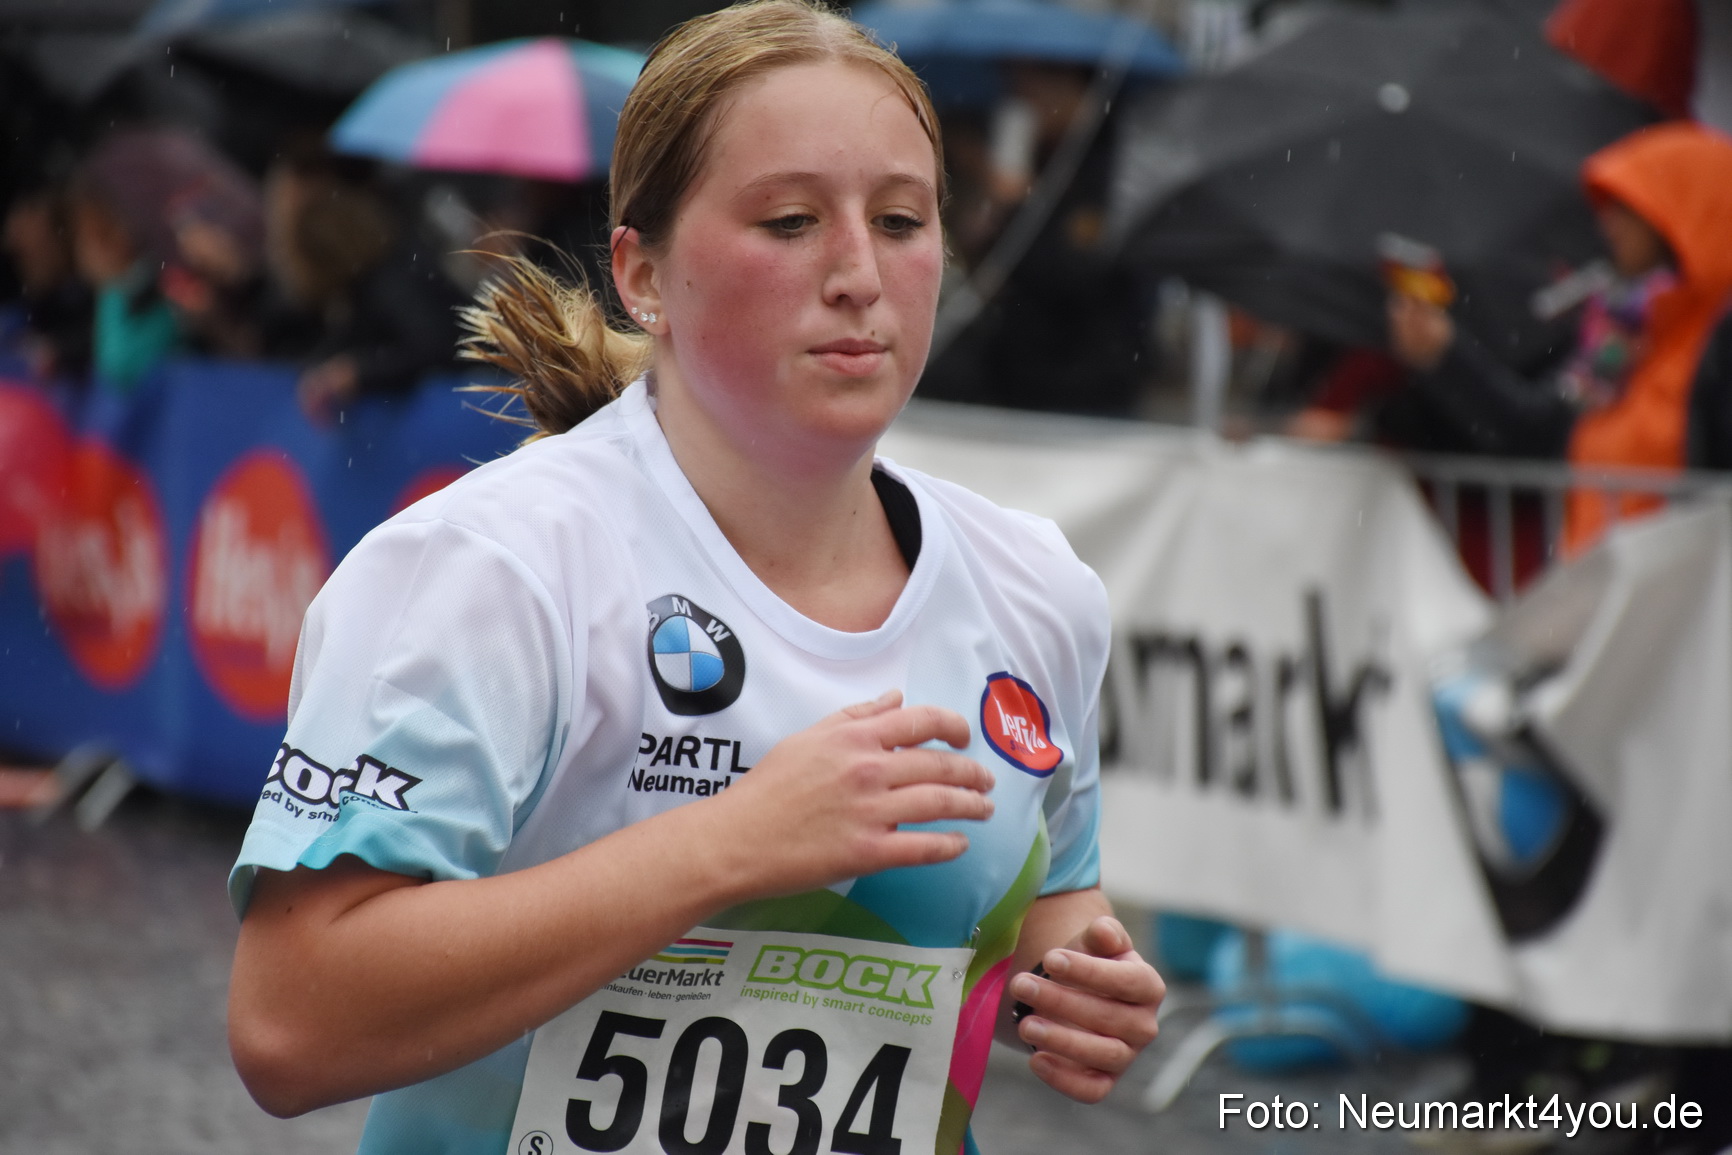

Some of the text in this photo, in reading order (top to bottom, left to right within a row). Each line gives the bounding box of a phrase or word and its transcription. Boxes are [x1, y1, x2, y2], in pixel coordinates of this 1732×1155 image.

[284, 797, 304, 818] by
[620, 966, 725, 987] uerMarkt
[746, 944, 942, 1010] BOCK
[601, 983, 711, 1002] inkaufen leben genießen
[740, 985, 933, 1027] inspired by smart concepts
[565, 1010, 912, 1155] 5034
